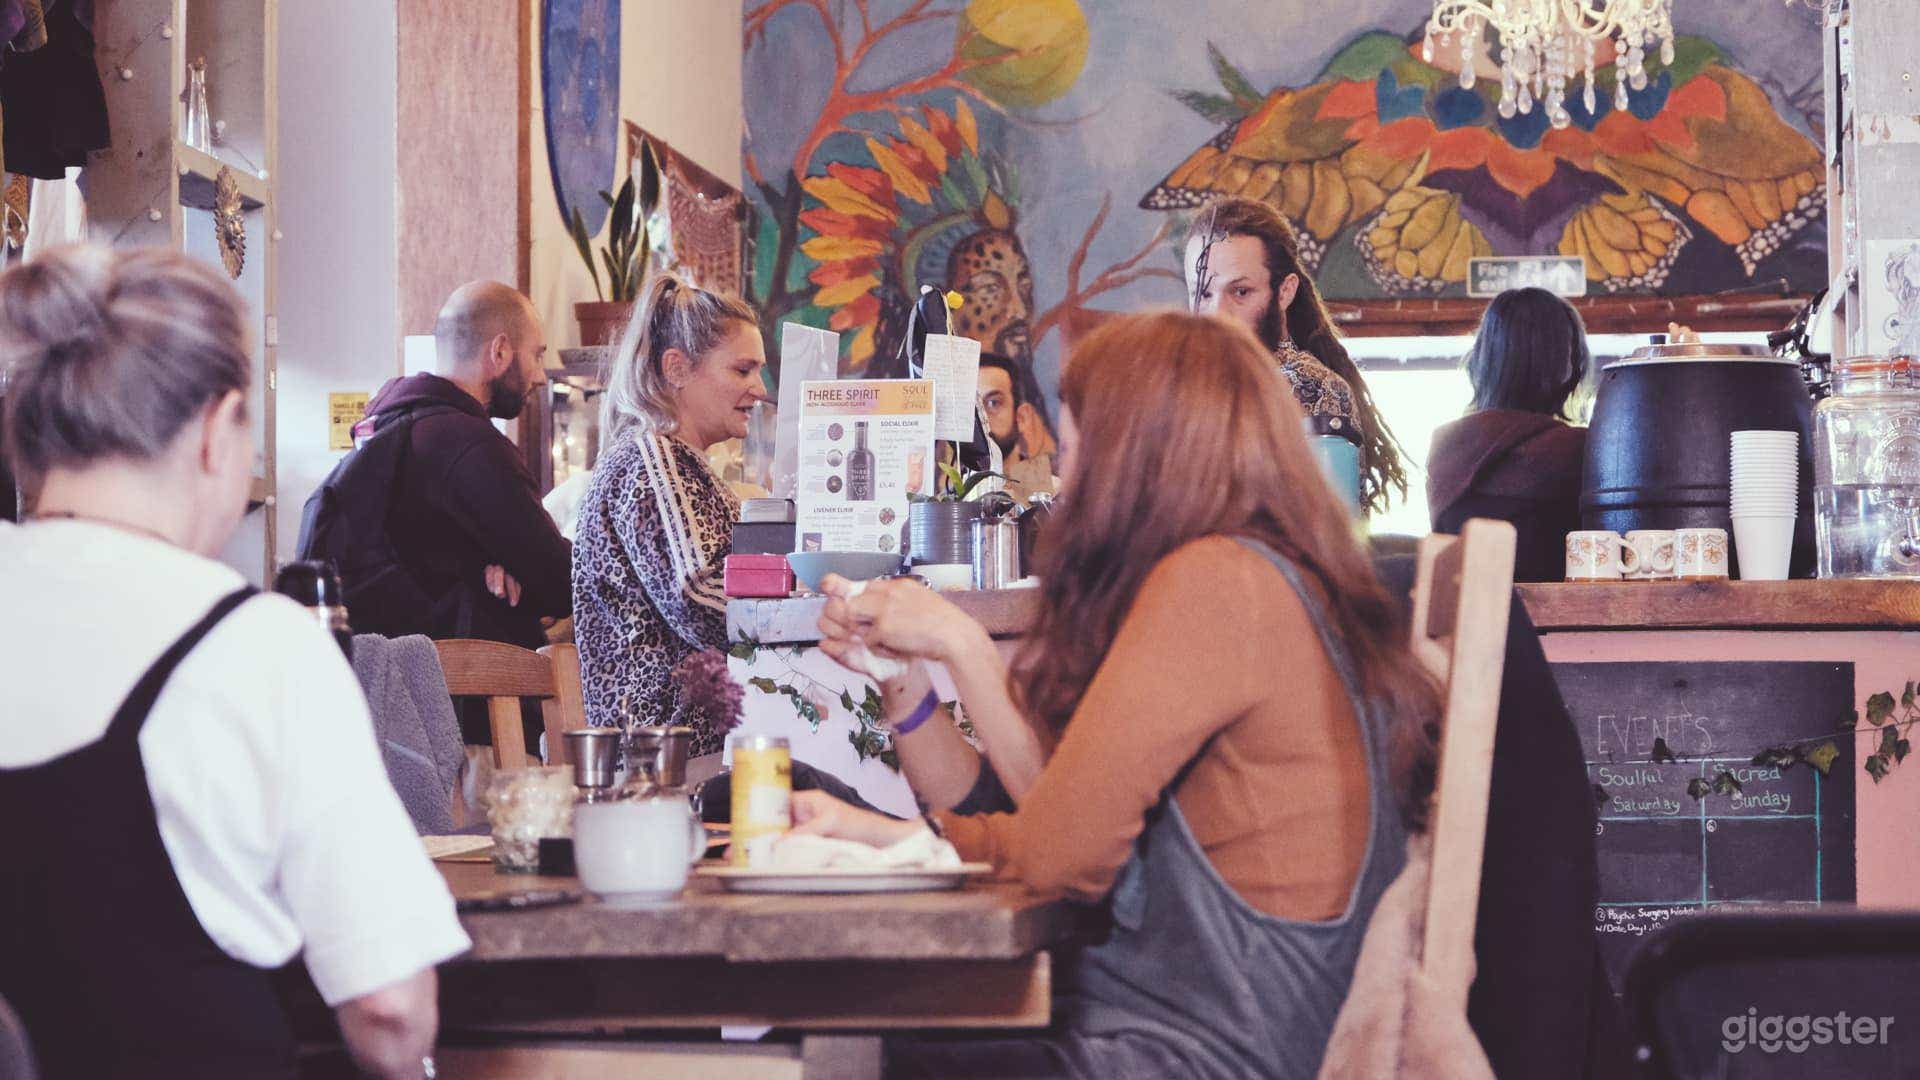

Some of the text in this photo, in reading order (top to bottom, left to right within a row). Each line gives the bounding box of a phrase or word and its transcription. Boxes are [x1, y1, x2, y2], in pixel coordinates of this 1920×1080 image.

[1478, 263, 1508, 276] Fire
[807, 389, 880, 401] THREE SPIRIT
[1598, 714, 1713, 755] EVENTS
[1599, 767, 1663, 786] Soulful
[1613, 795, 1680, 815] Saturday
